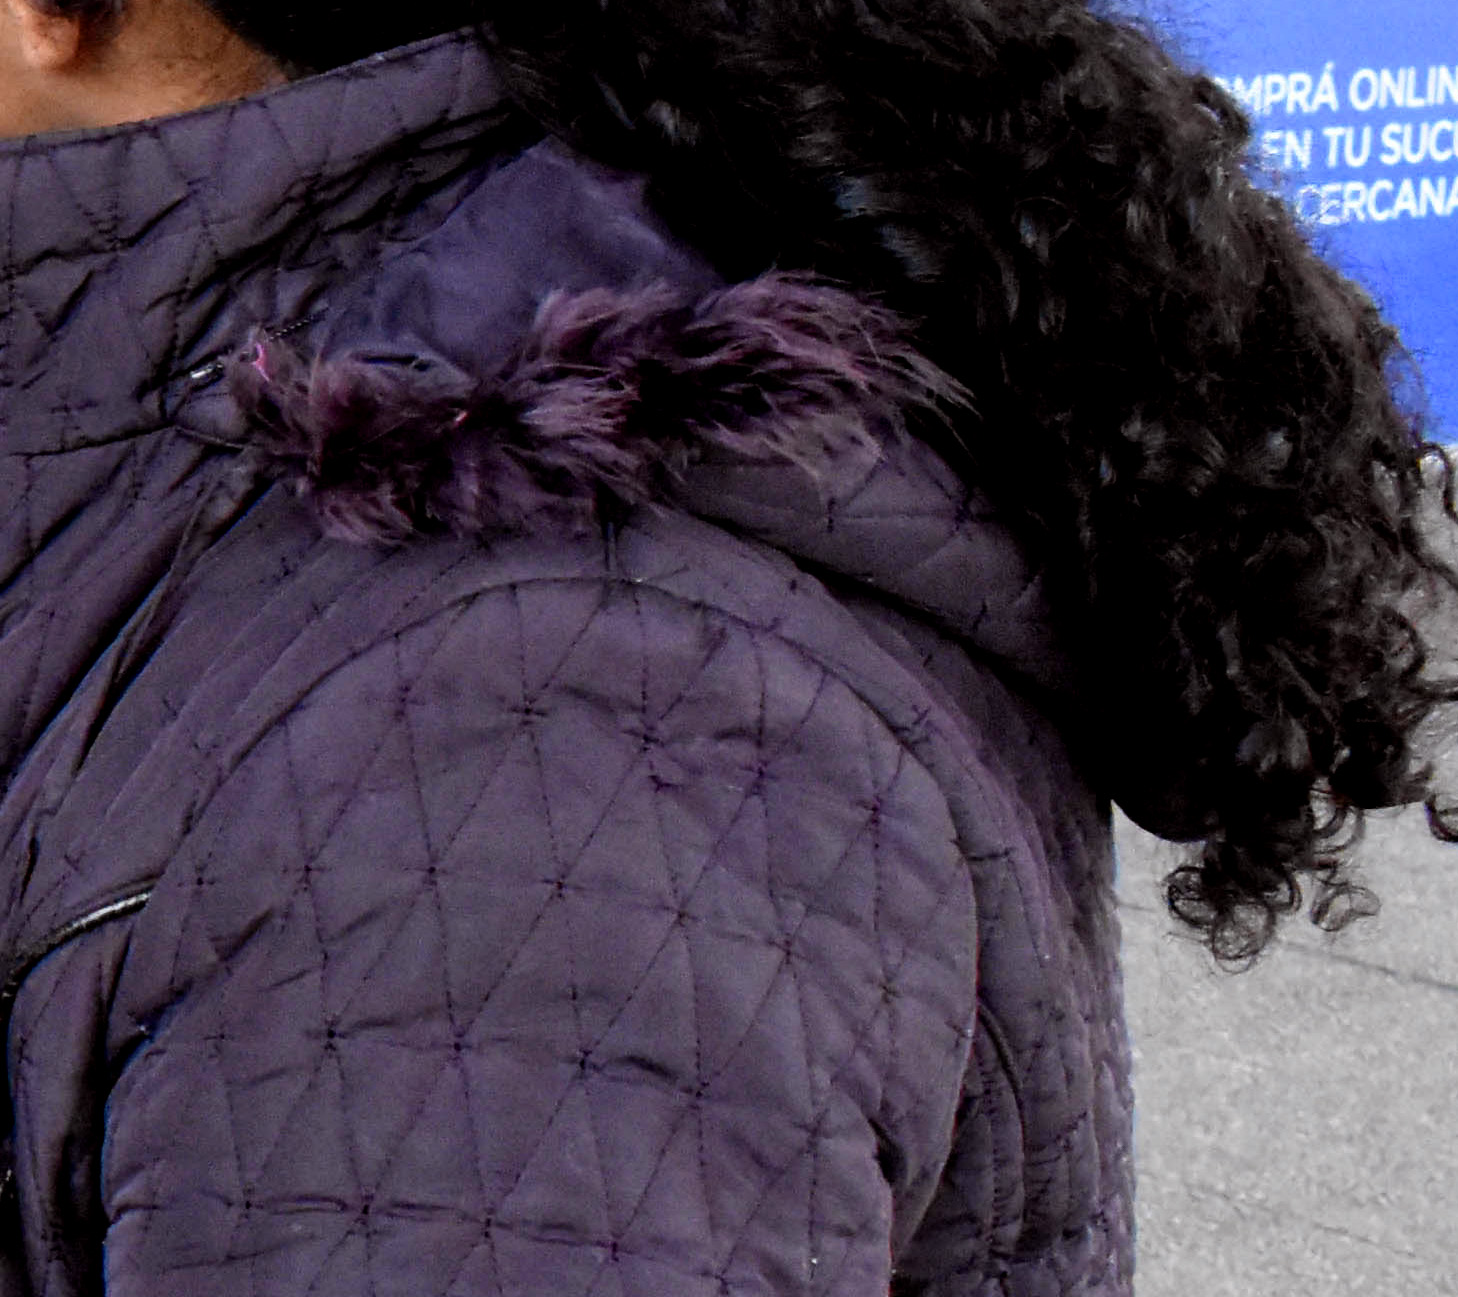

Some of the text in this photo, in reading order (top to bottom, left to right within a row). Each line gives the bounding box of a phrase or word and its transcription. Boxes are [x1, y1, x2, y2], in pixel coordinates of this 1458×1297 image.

[1215, 62, 1340, 116] MPRÁ
[1323, 125, 1371, 168] TU
[1380, 120, 1458, 165] SUC
